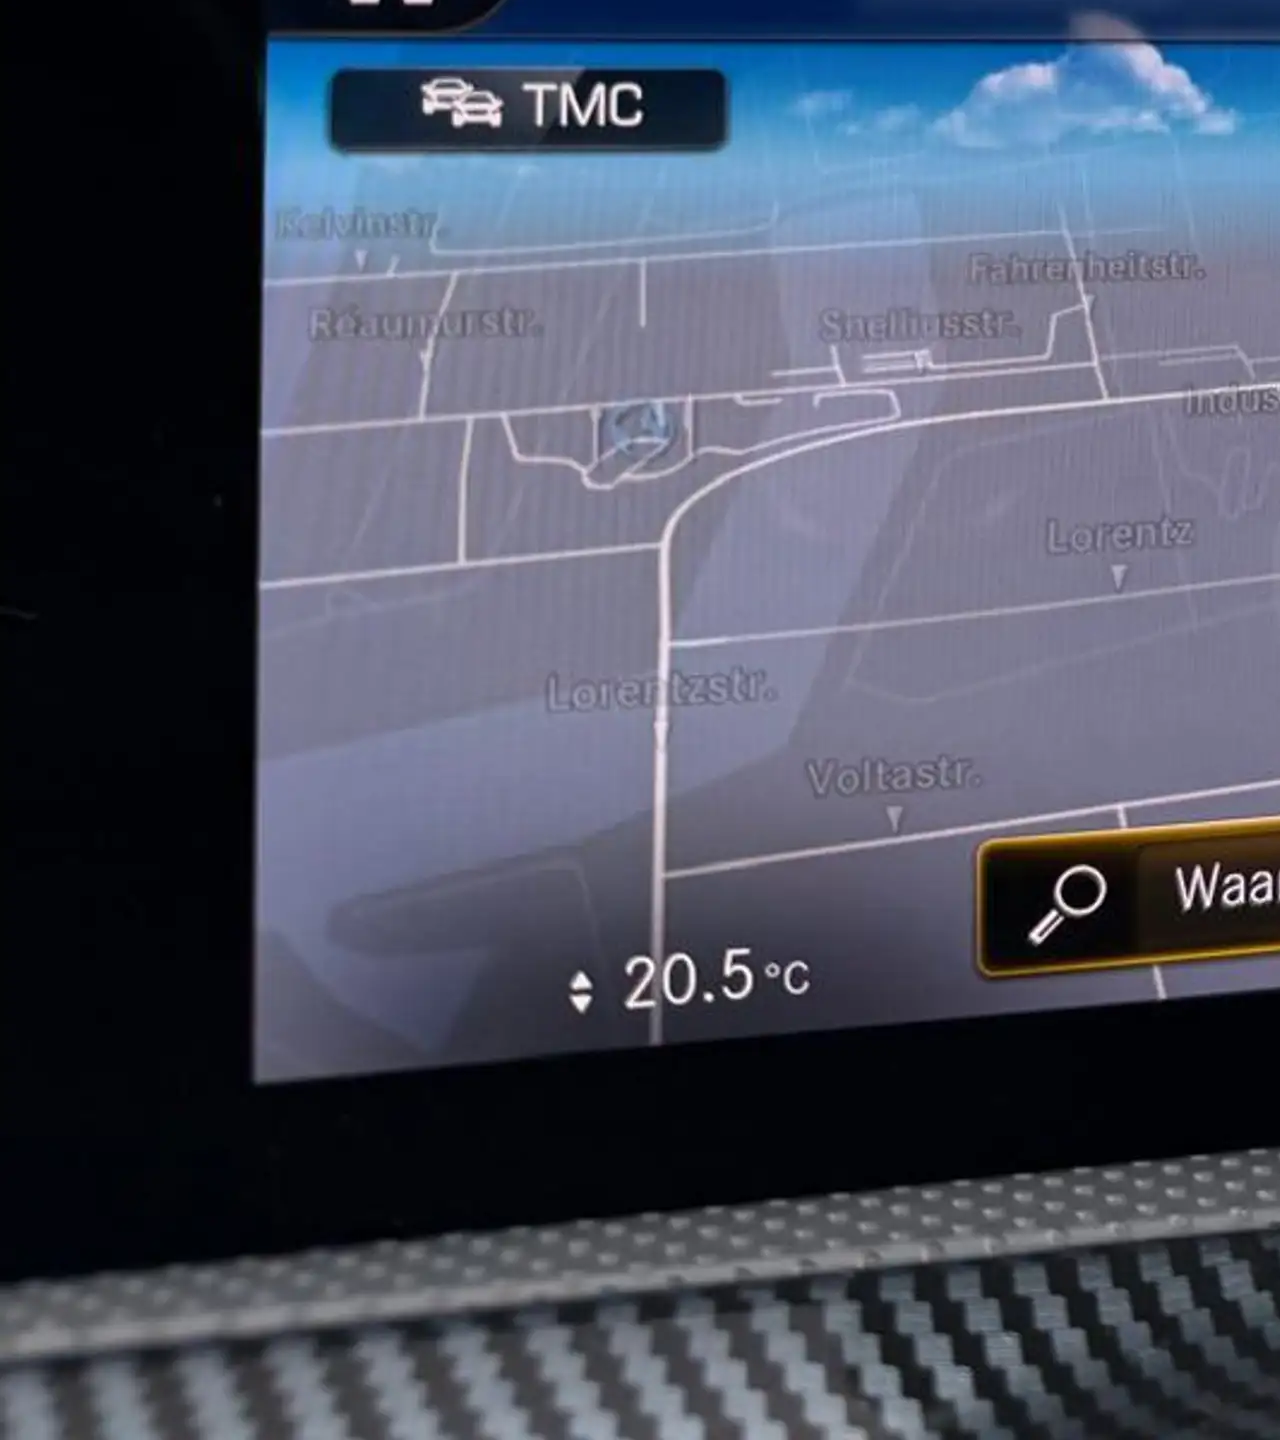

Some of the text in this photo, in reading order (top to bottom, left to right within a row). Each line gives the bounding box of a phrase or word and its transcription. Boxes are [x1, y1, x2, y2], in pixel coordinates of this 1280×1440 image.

[522, 81, 645, 128] TMC
[967, 250, 1207, 285] Fahrenheitstr.
[818, 305, 1023, 345] Snelliusstr.
[1046, 515, 1195, 556] Lorentz
[547, 666, 777, 714] Lorentzstr.
[805, 756, 984, 799] Voltastr.
